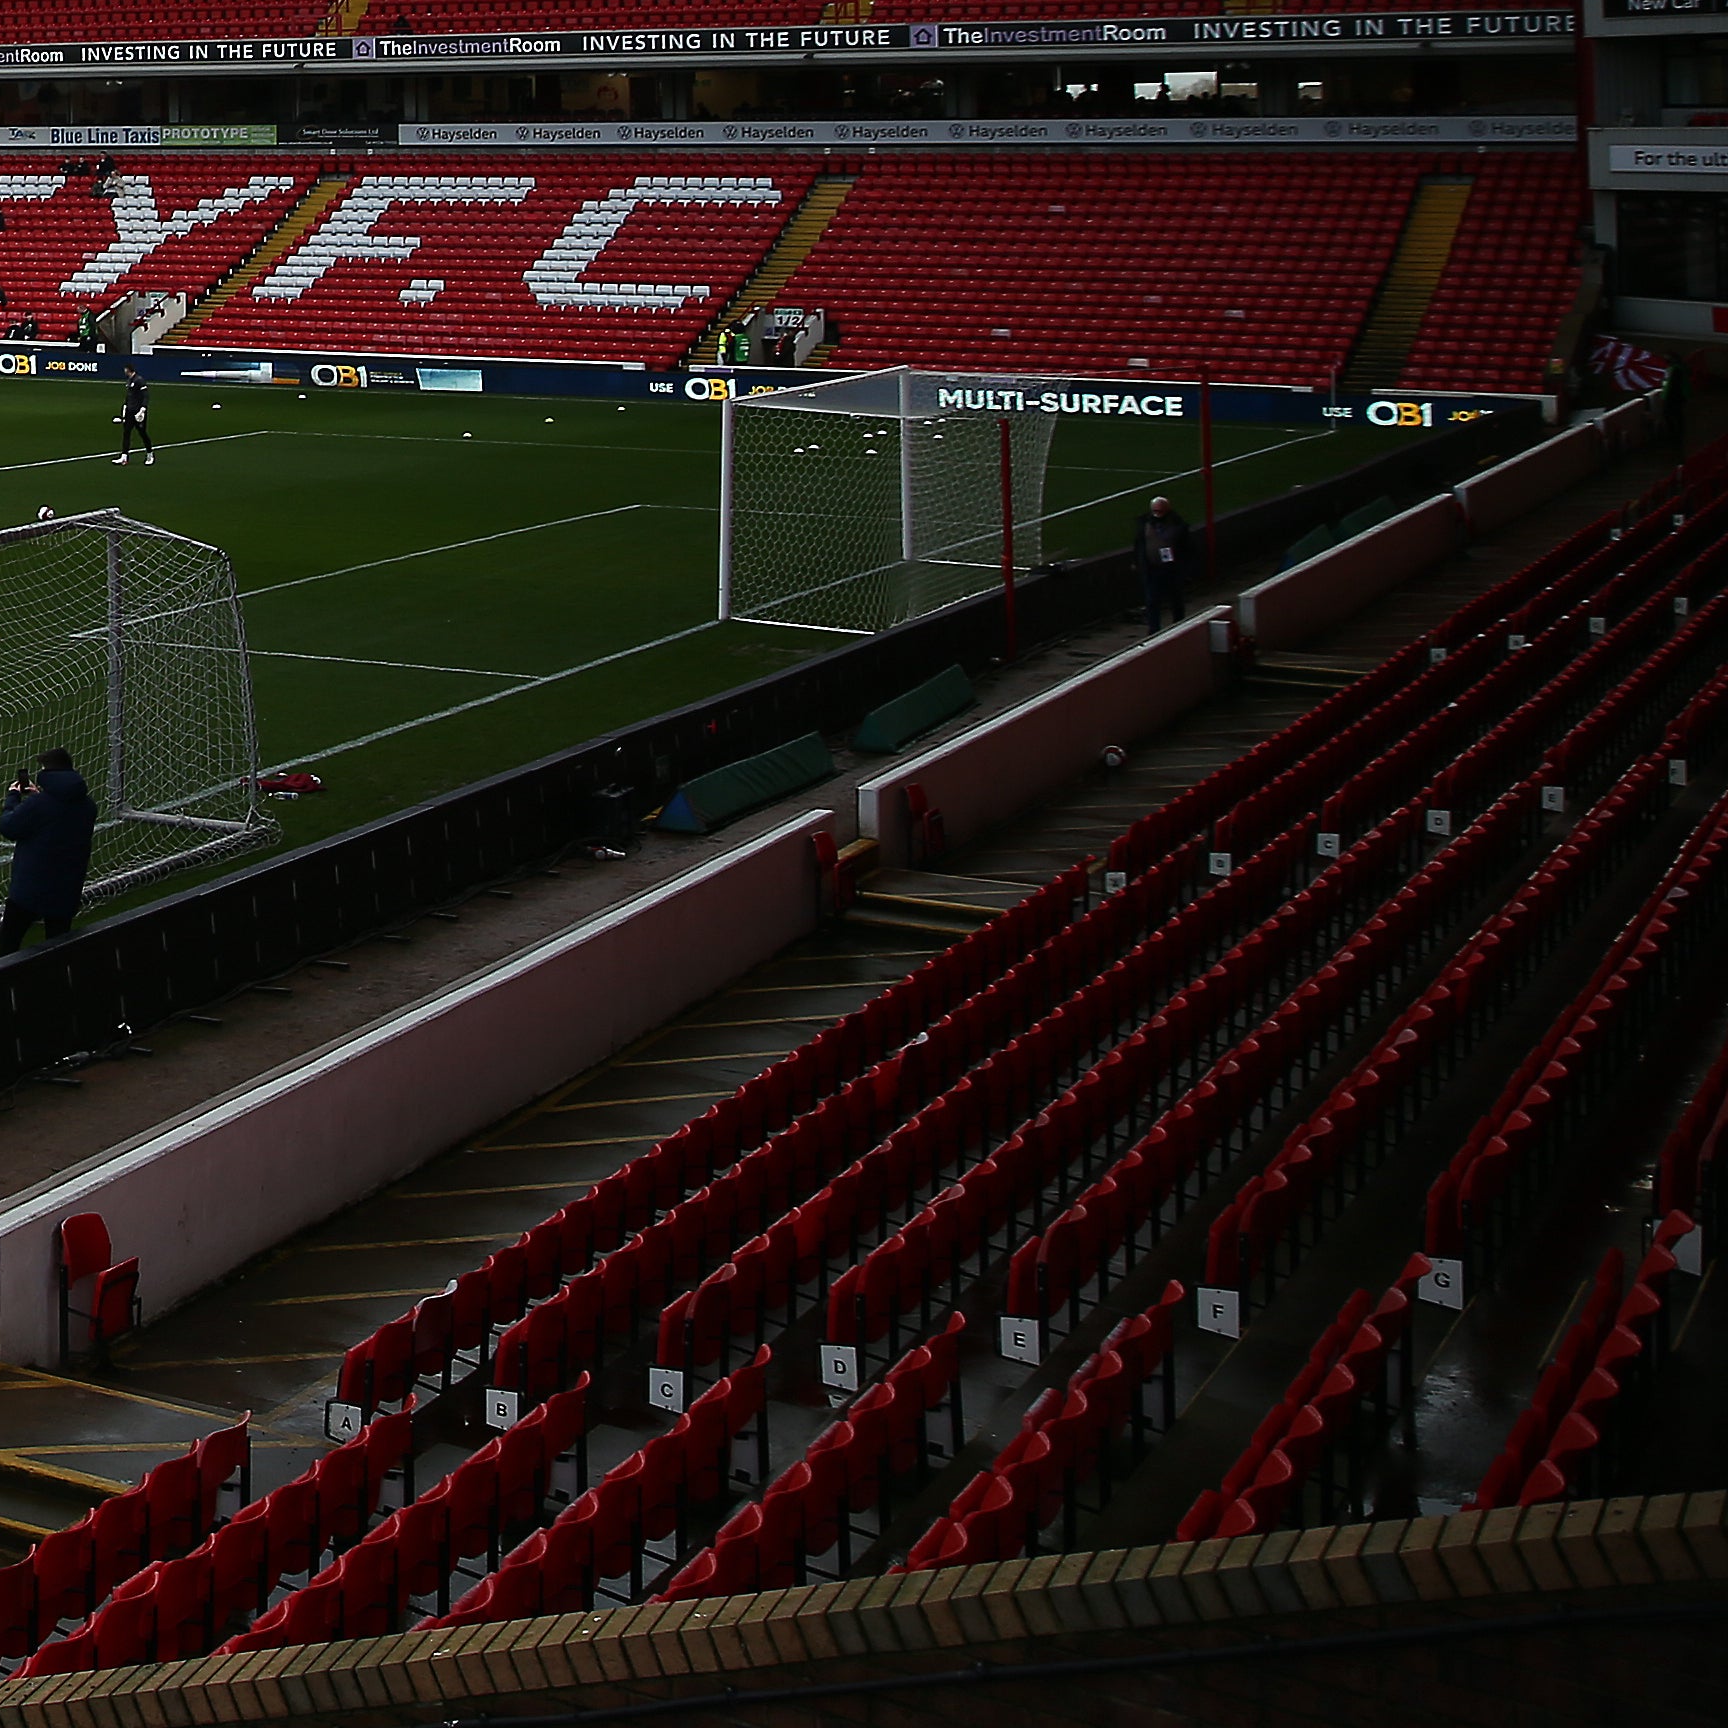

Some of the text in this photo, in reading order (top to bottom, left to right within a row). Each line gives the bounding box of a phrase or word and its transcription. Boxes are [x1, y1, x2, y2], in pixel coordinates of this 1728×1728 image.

[1194, 20, 1341, 39] INVESTING
[1356, 19, 1383, 36] IN
[1397, 18, 1452, 35] THE
[1468, 15, 1576, 33] FUTURE
[583, 34, 701, 51] INVESTING
[712, 33, 735, 49] IN
[745, 32, 790, 48] THE
[800, 29, 891, 47] FUTURE
[81, 45, 180, 63] INVESTING
[189, 45, 208, 60] IN
[216, 44, 254, 59] THE
[259, 42, 337, 59] FUTURE
[51, 128, 160, 144] Blue Line Taxis
[162, 127, 248, 140] PROTOTYPE
[431, 128, 497, 142] Hayselden
[532, 127, 601, 142] Hayselden
[634, 126, 704, 142] Hayselden
[741, 127, 814, 141] Hayselden
[852, 126, 928, 141] Hayselden
[969, 125, 1048, 141] Hayselden
[1084, 123, 1168, 140] Hayselden
[1212, 123, 1299, 140] Hayselden
[1347, 122, 1440, 139] Hayselden
[1634, 151, 1662, 165] For
[1667, 151, 1696, 165] the
[45, 361, 66, 371] JOB
[67, 362, 98, 372] DONE
[310, 364, 368, 389] OB1
[649, 382, 674, 393] USE
[684, 377, 738, 401] OB1
[937, 387, 1184, 418] MULTI-SURFACE
[1322, 400, 1433, 429] USE OB1
[1434, 1272, 1450, 1288] G
[1212, 1305, 1224, 1319] F
[1013, 1332, 1026, 1348] E
[834, 1359, 846, 1374] D
[660, 1383, 673, 1398] C
[496, 1403, 507, 1417] B
[341, 1416, 352, 1431] A
